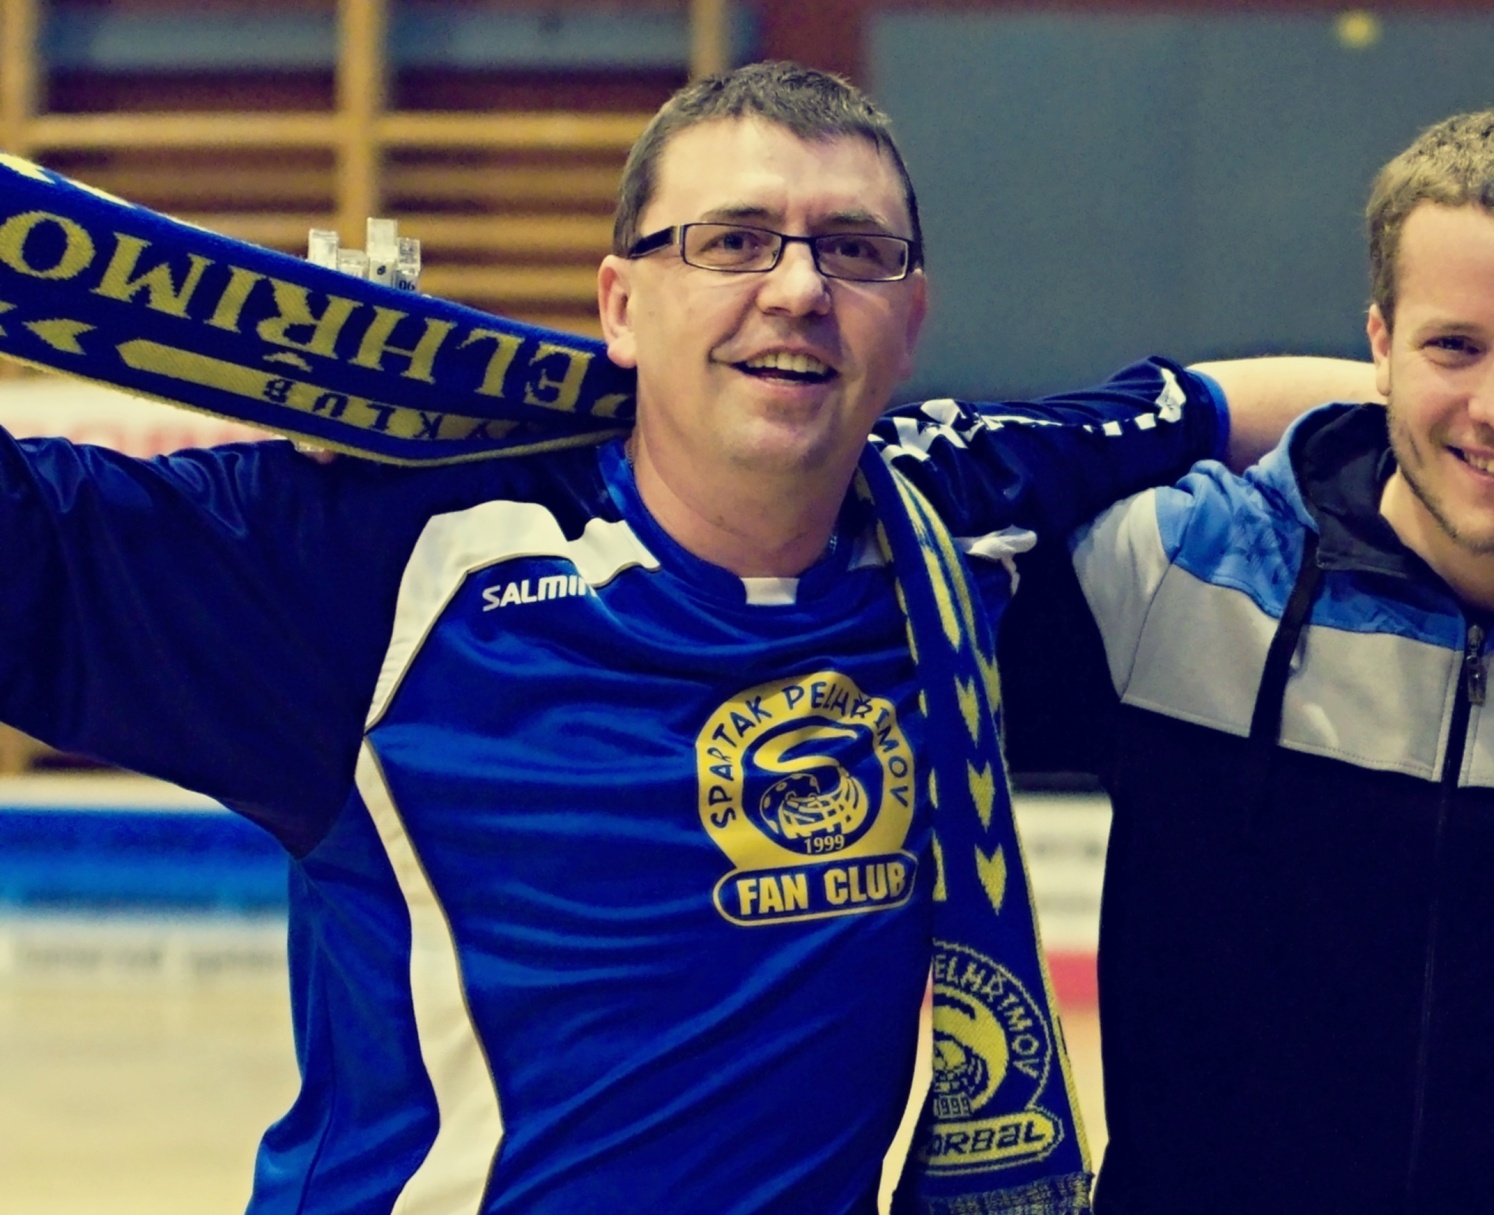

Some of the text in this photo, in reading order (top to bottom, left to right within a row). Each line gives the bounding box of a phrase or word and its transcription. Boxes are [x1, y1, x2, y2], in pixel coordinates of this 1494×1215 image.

[263, 377, 440, 441] KLUB
[707, 681, 909, 829] SPARTAK PELHŘIMOV
[803, 834, 846, 855] 1999
[736, 861, 906, 917] FAN CLUB
[934, 954, 1040, 1080] ELHŘIMOV
